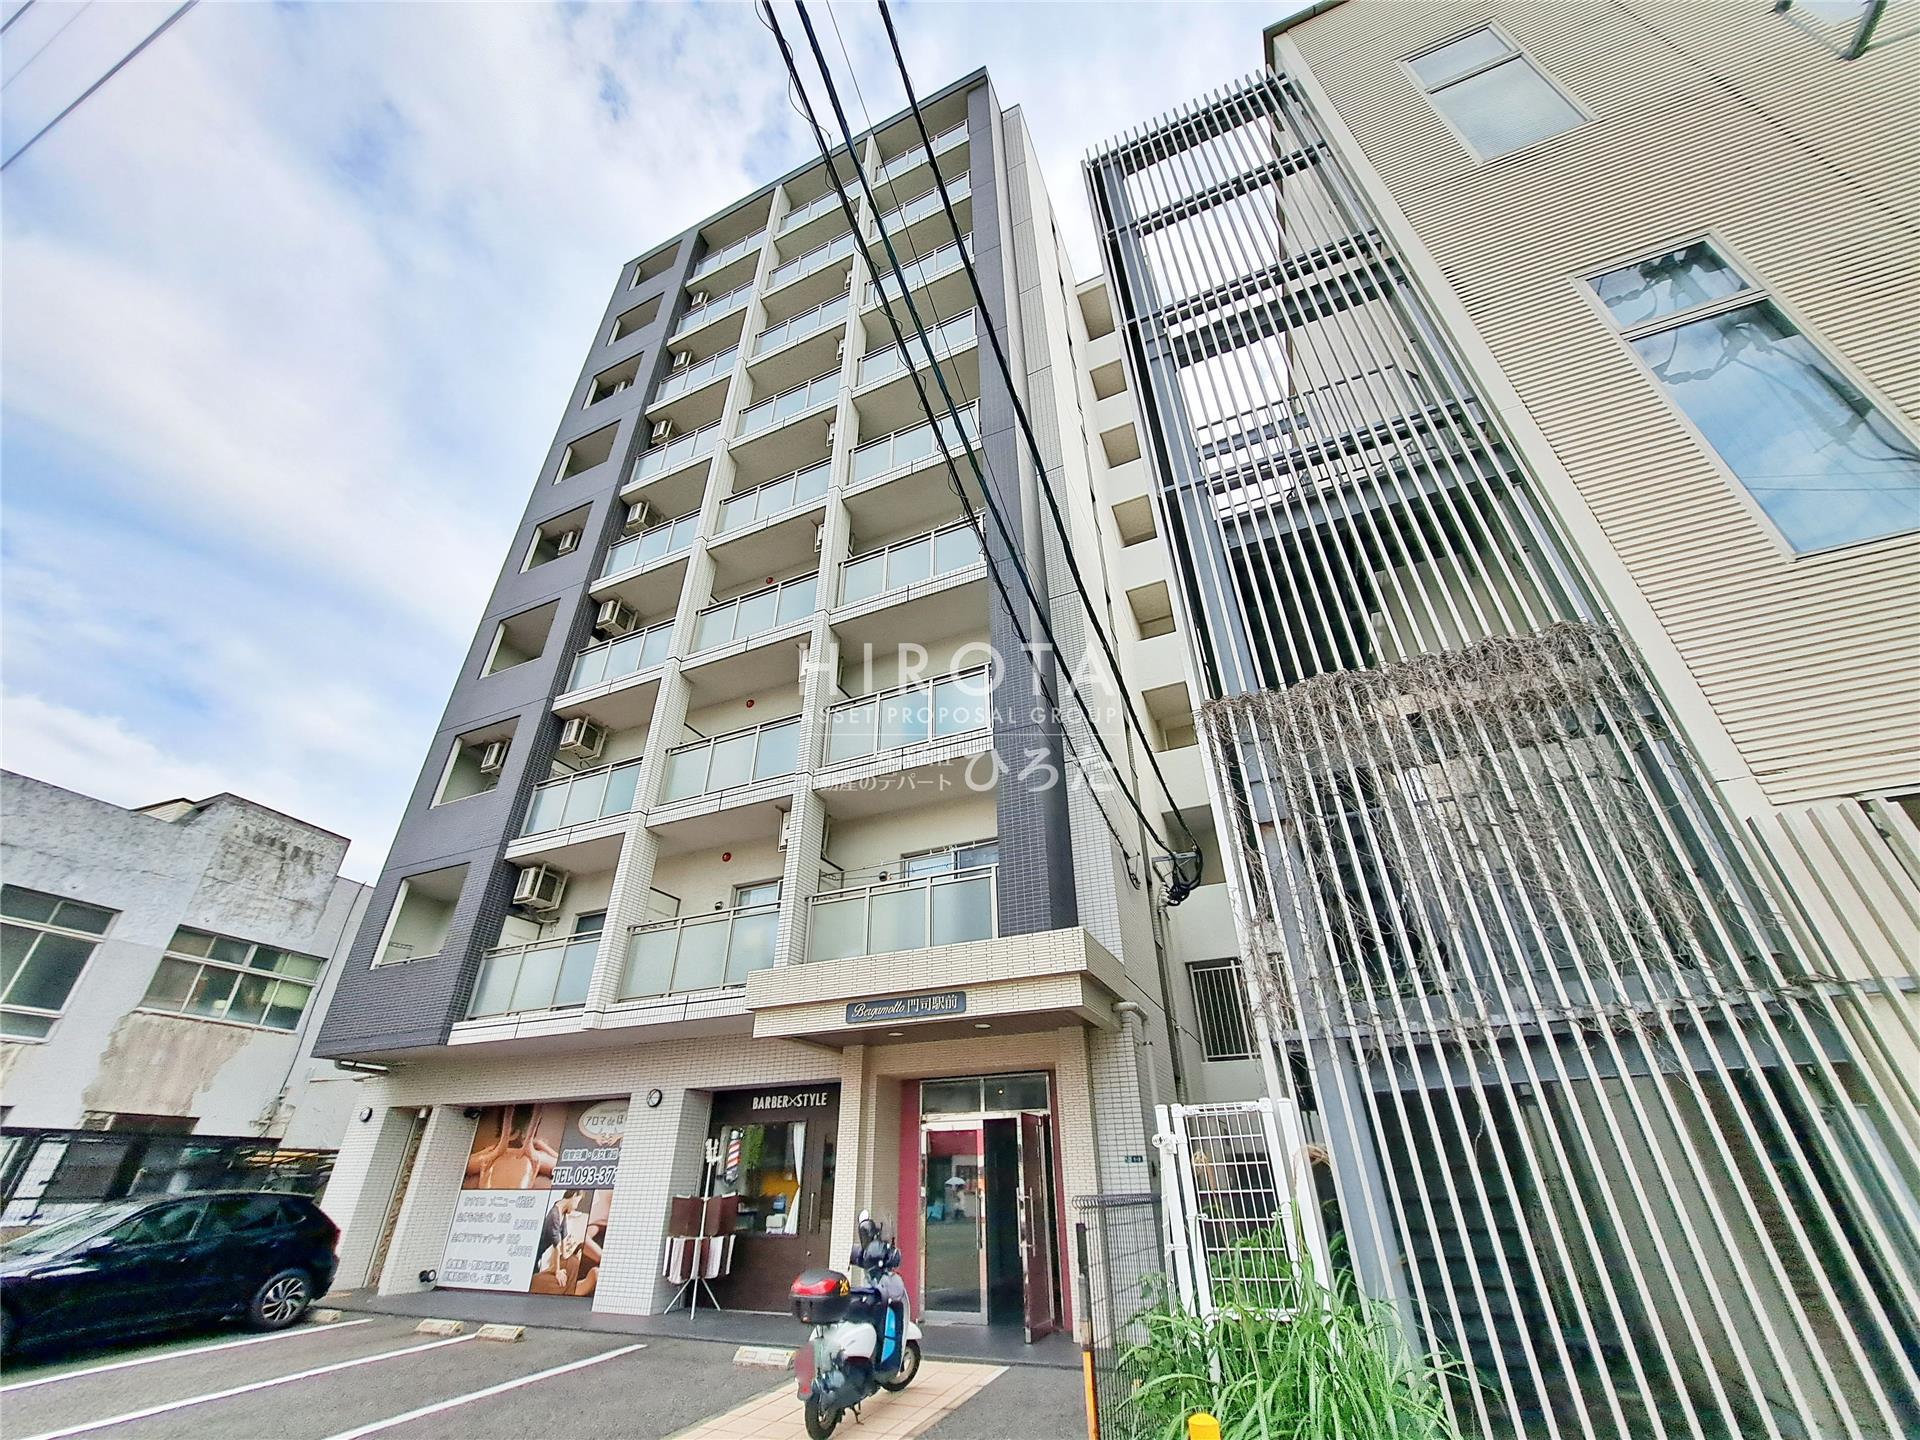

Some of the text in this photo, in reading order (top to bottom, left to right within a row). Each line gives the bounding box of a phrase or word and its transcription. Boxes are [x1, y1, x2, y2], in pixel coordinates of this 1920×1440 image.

[907, 994, 958, 1013] 門司駅前
[553, 1167, 571, 1184] TEL
